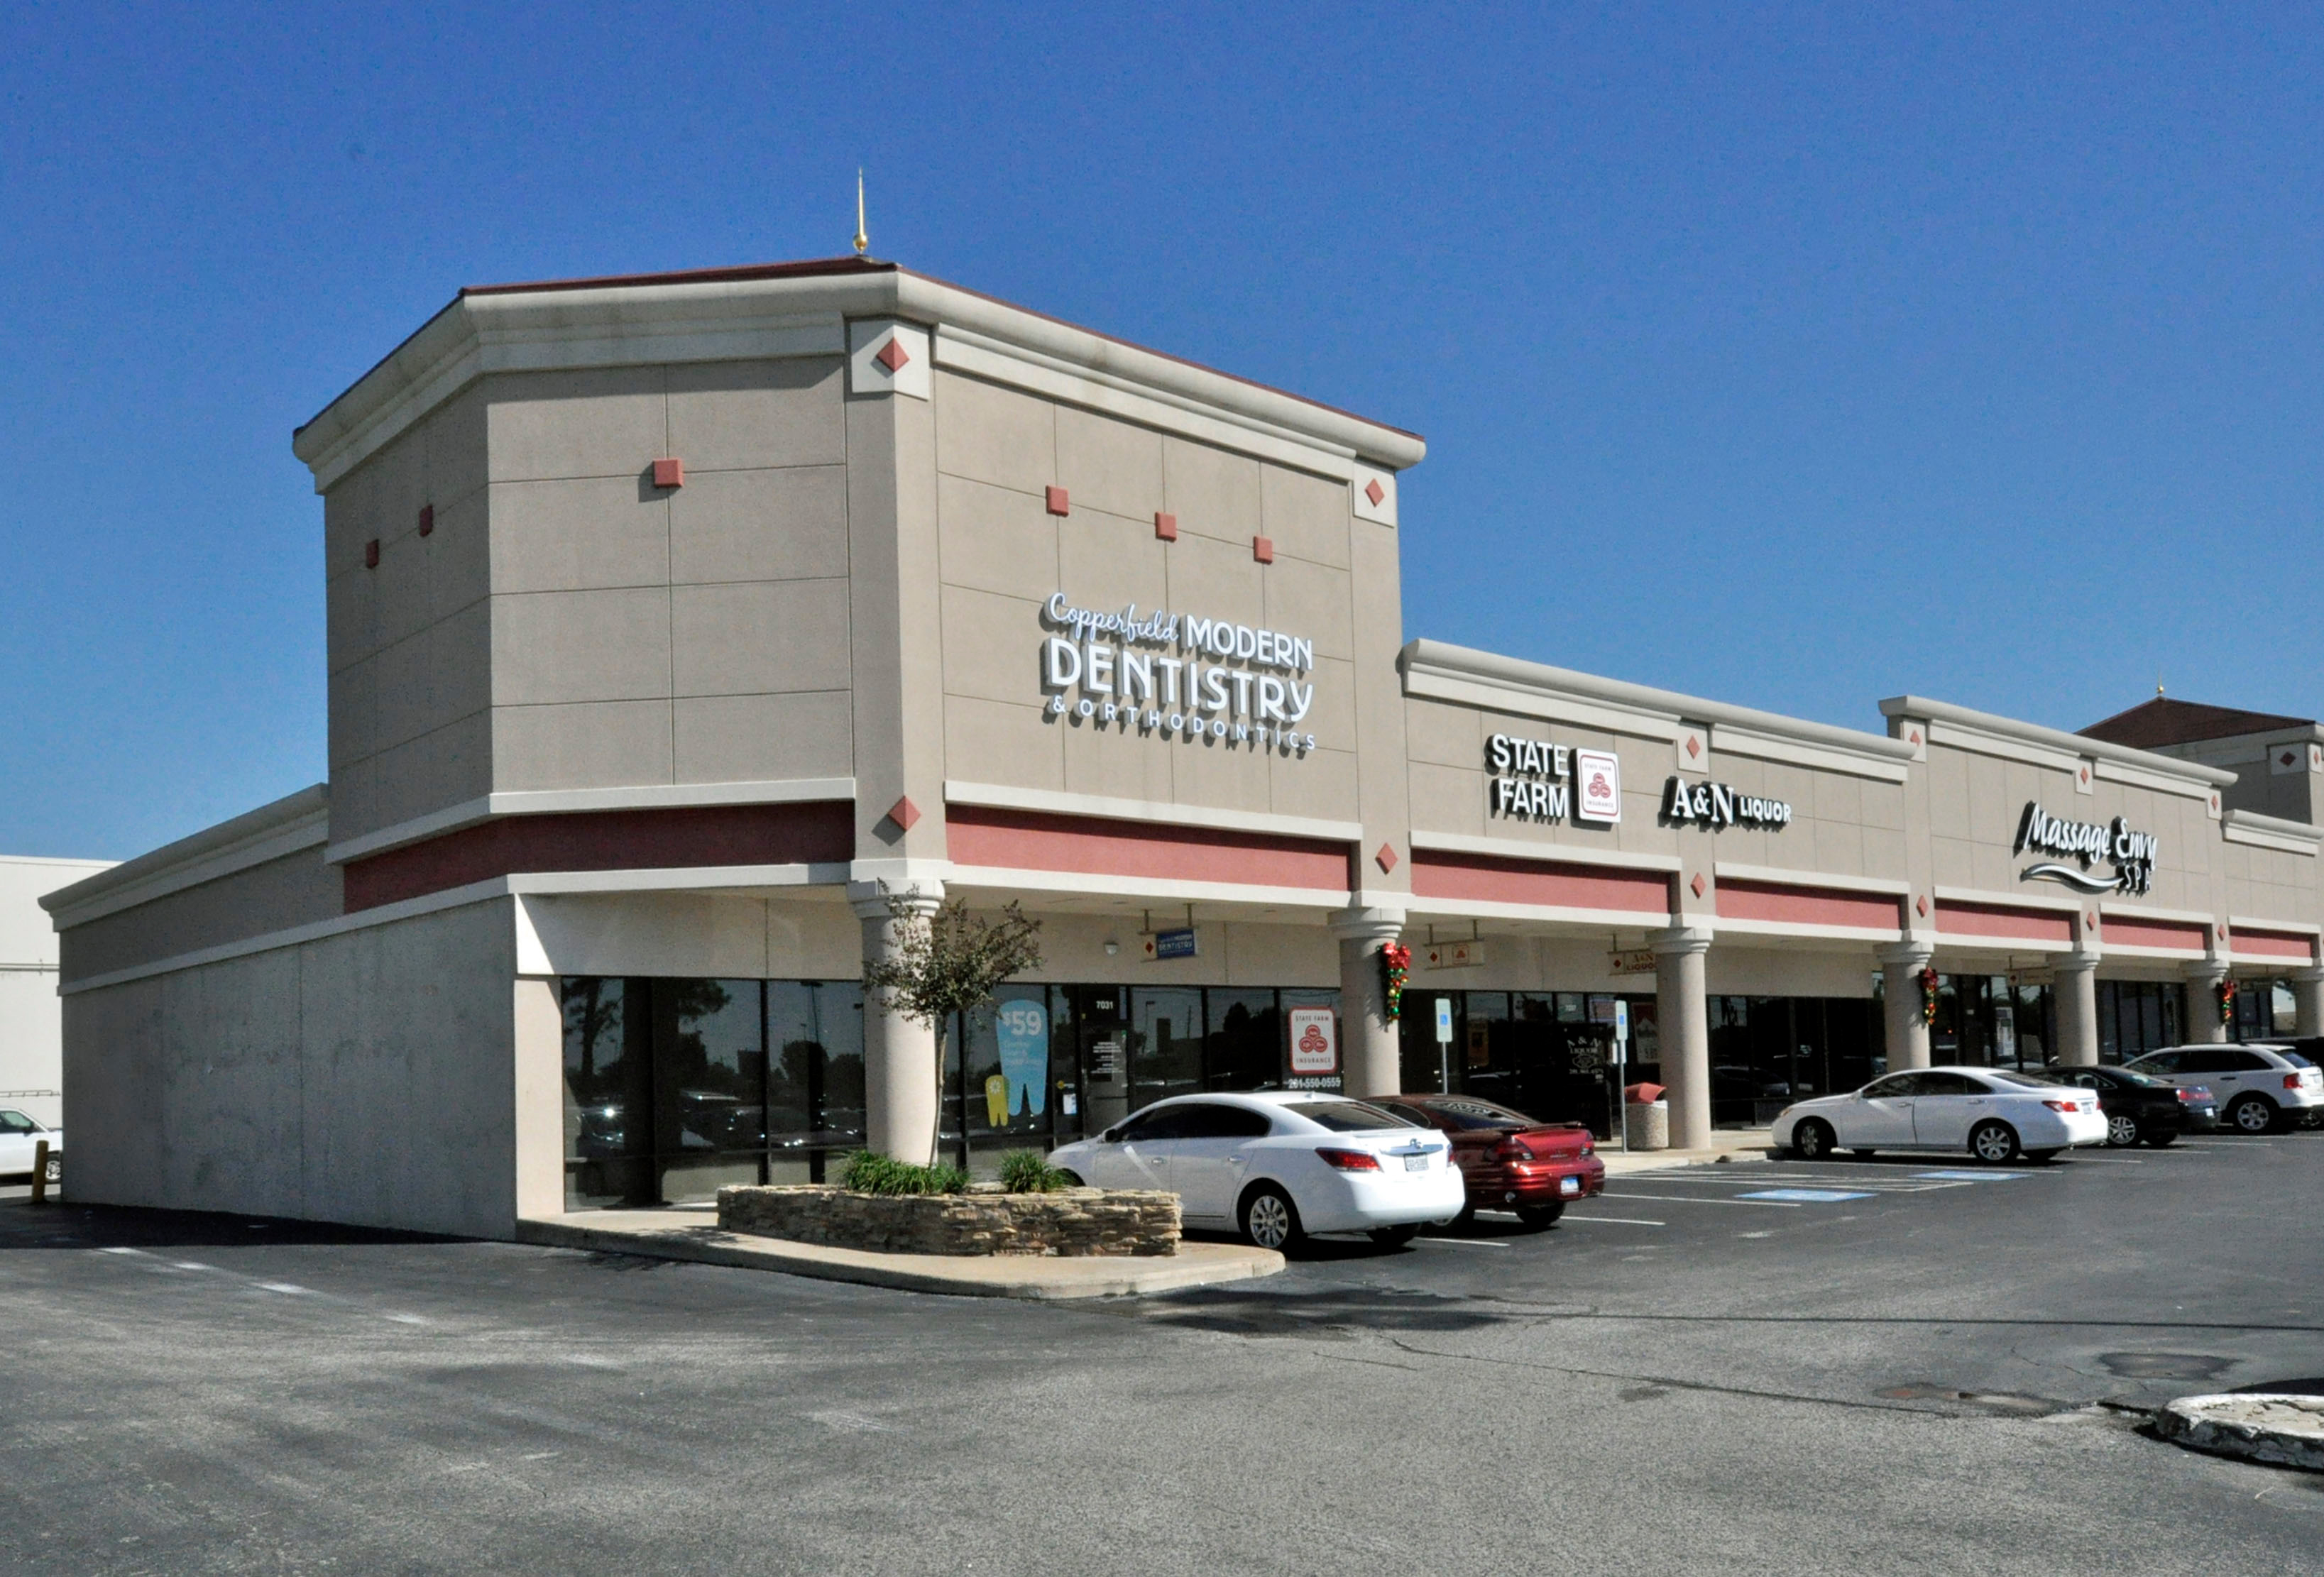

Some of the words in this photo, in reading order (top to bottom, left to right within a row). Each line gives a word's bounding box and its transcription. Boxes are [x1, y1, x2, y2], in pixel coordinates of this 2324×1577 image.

[1047, 592, 1179, 642] Copperfield
[1185, 615, 1313, 671] MODERN
[1048, 637, 1314, 723] DENTISTRY
[1052, 695, 1065, 713] &
[1078, 698, 1315, 751] ORTHODONTICS
[1491, 733, 1570, 776] STATE
[1498, 778, 1569, 818] FARM
[1670, 779, 1734, 823] A&N
[1740, 796, 1792, 822] LIQUOR
[2023, 803, 2111, 864] Massage
[2115, 818, 2157, 872] Envy
[2124, 864, 2152, 891] SPA
[1002, 1011, 1041, 1036] $59
[1095, 1000, 1114, 1009] 7031
